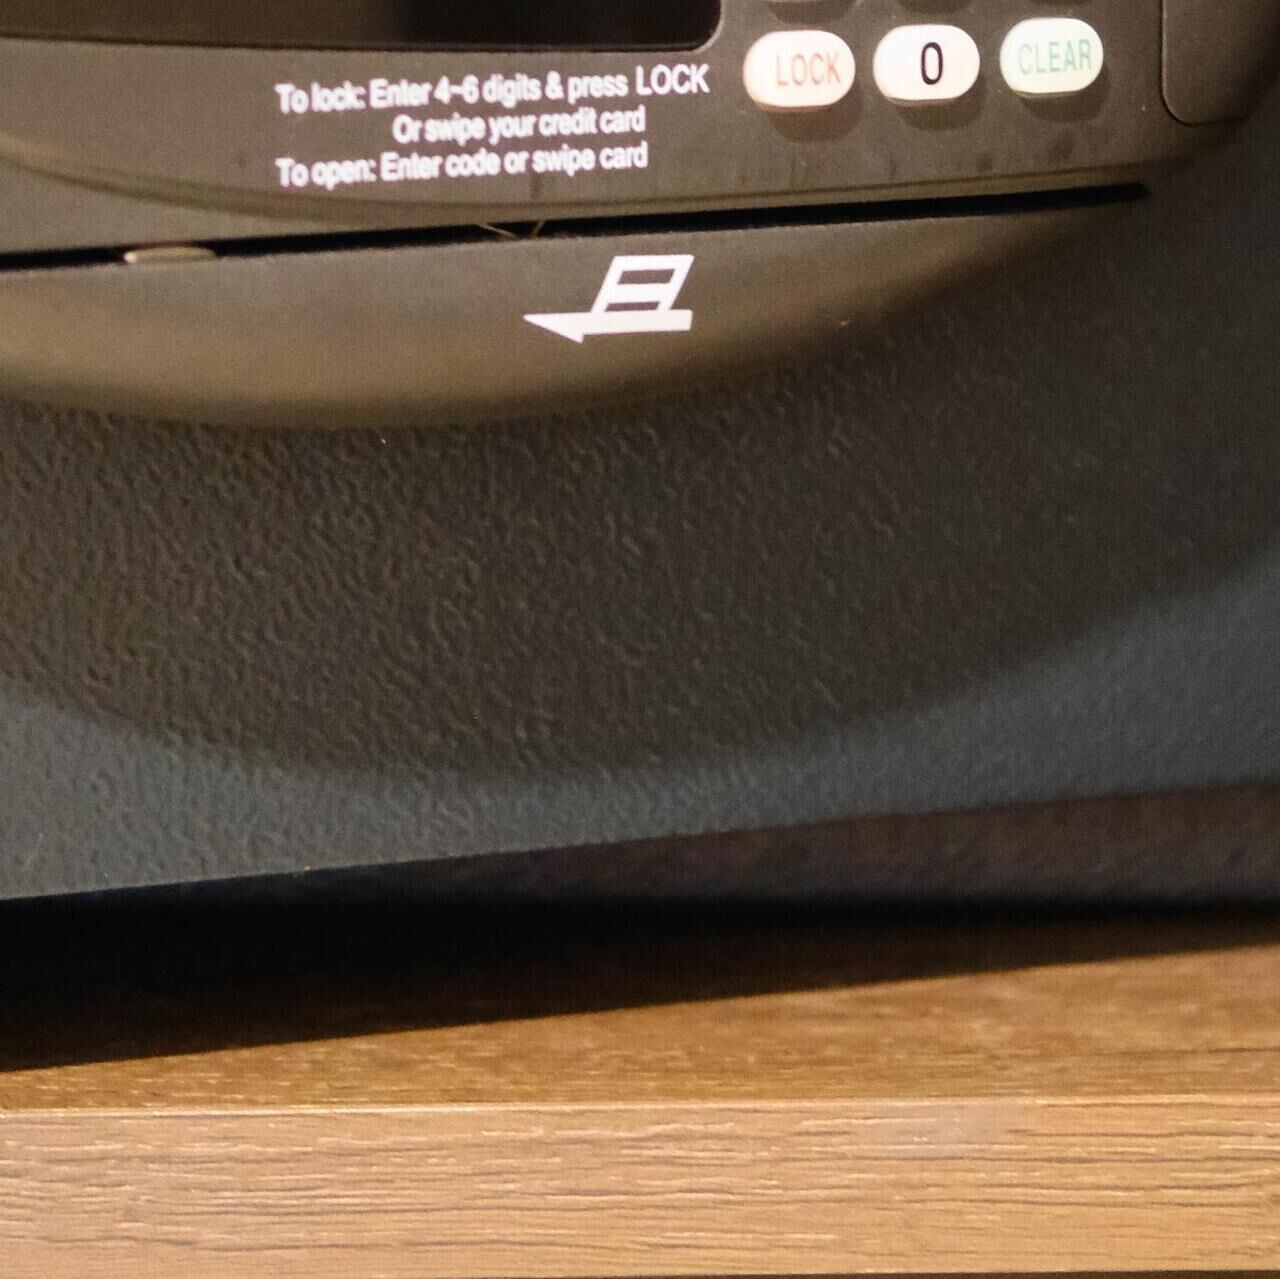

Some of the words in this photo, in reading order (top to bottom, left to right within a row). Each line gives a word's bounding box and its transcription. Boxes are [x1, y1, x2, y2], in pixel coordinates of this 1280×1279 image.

[774, 50, 842, 87] LOCK
[920, 41, 944, 86] 0
[1018, 38, 1093, 76] CLEAR
[274, 83, 309, 114] To
[310, 80, 367, 112] lock:
[369, 77, 433, 109] Enter
[434, 74, 480, 105] 4-6
[482, 72, 542, 108] digits
[545, 70, 564, 100] &
[568, 73, 629, 104] press
[635, 63, 710, 96] LOCK
[392, 114, 424, 145] Or
[423, 112, 487, 147] swipe
[487, 115, 537, 146] your
[538, 107, 598, 135] credit
[599, 104, 646, 134] card
[274, 157, 310, 188] To
[310, 158, 377, 191] open:
[379, 151, 444, 182] Enter
[445, 147, 502, 178] code
[503, 151, 531, 174] or
[531, 143, 596, 177] swipe
[599, 140, 649, 169] card
